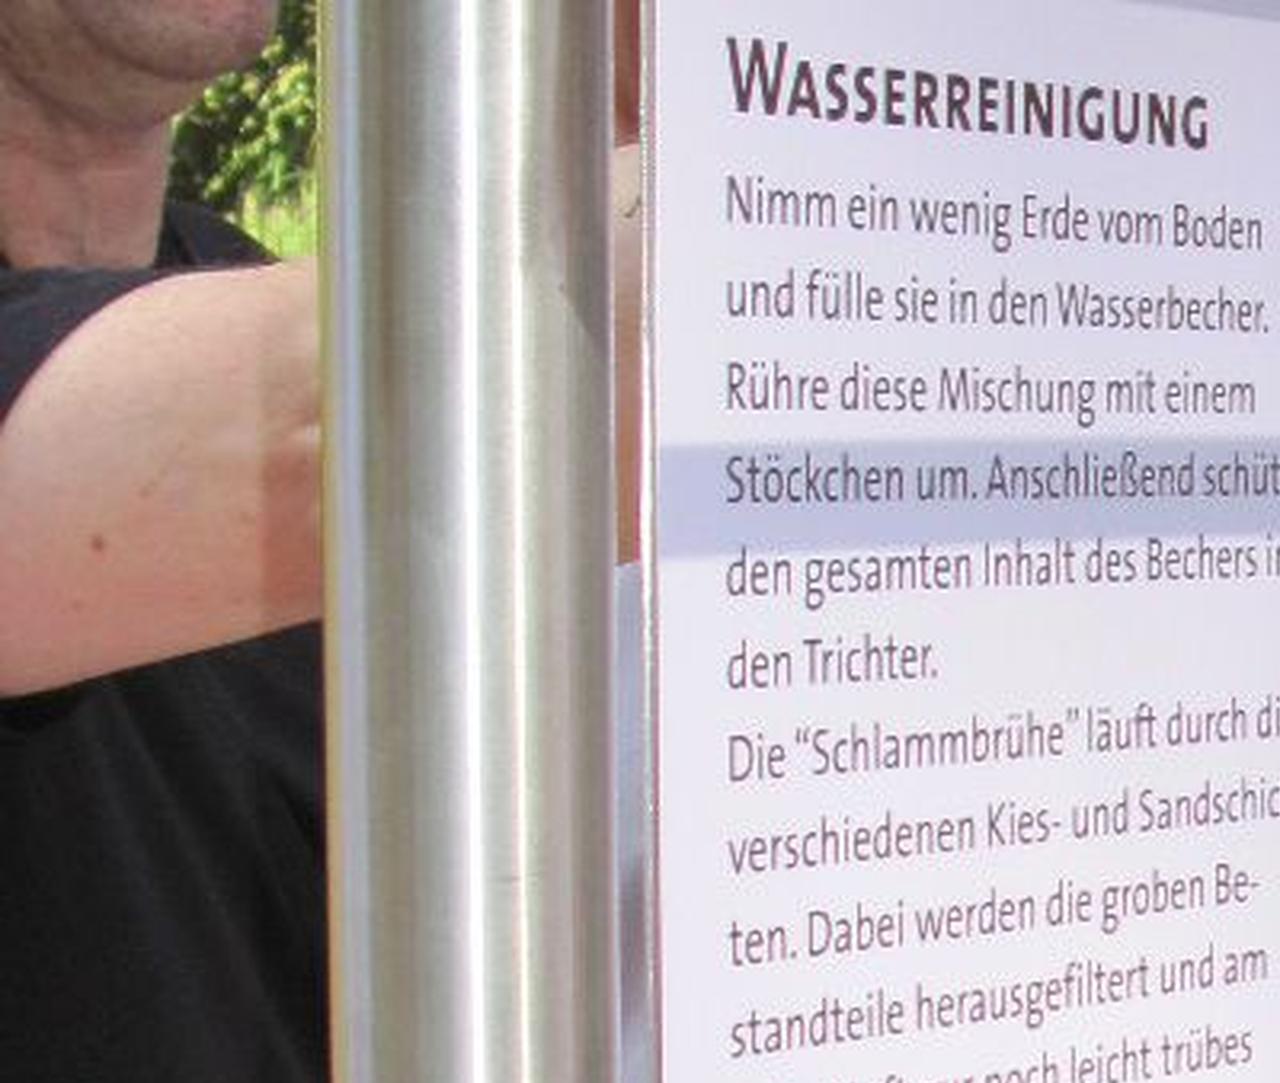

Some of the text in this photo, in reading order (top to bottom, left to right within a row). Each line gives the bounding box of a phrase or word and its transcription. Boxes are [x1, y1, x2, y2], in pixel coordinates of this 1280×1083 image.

[724, 35, 1209, 152] WASSERREINIGUNG
[726, 174, 1263, 254] Nimm ein wenig Erde vom Boden
[726, 267, 1269, 334] und fülle sie in den Wasserbecher.
[725, 359, 1256, 429] Rühre diese Mischung mit einem
[725, 450, 904, 504] Stöckchen
[916, 465, 978, 502] um.
[984, 450, 1195, 500] Anschließend
[725, 544, 792, 597] den
[803, 545, 972, 612] gesamten
[984, 536, 1076, 587] Inhalt
[1084, 536, 1138, 584] des
[1146, 533, 1259, 582] Bechers
[725, 632, 938, 691] den Trichter.
[727, 732, 787, 783] Die
[1086, 701, 1158, 753] läuft
[1166, 696, 1248, 747] durch
[726, 809, 976, 876] verschiedenen
[987, 801, 1062, 849] Kies-
[1071, 787, 1130, 840] und
[727, 862, 1261, 968] ten. Dabei werden die groben Be-
[730, 941, 1268, 1060] standteile herausgefiltert und am
[1160, 1024, 1253, 1077] trübes
